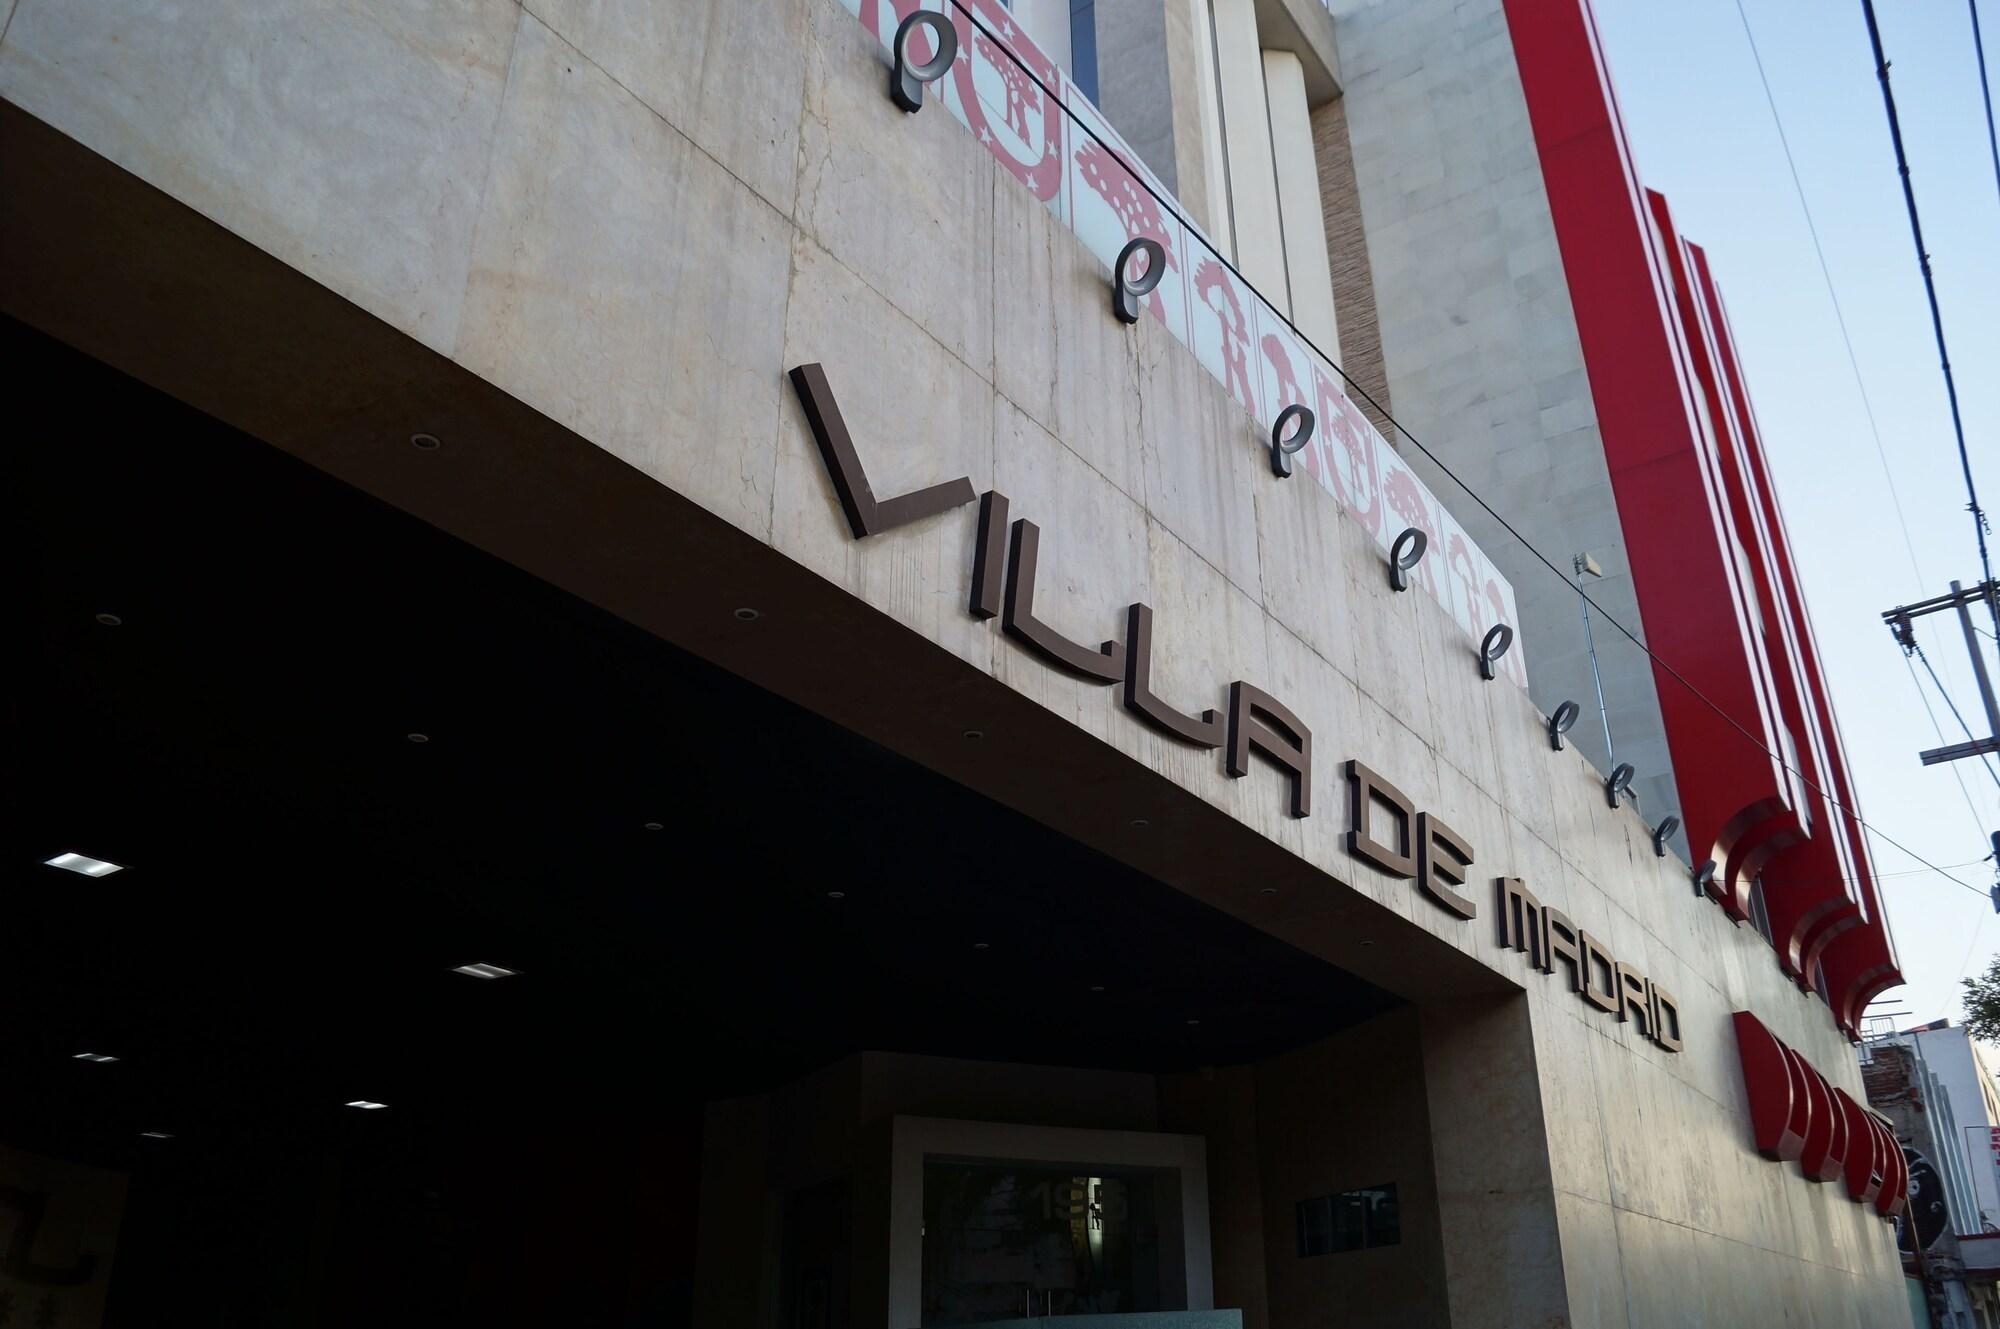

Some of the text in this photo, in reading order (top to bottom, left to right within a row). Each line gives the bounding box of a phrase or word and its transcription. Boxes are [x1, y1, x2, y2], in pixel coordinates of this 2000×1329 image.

[788, 362, 1683, 1053] VILLA DE MADRID
